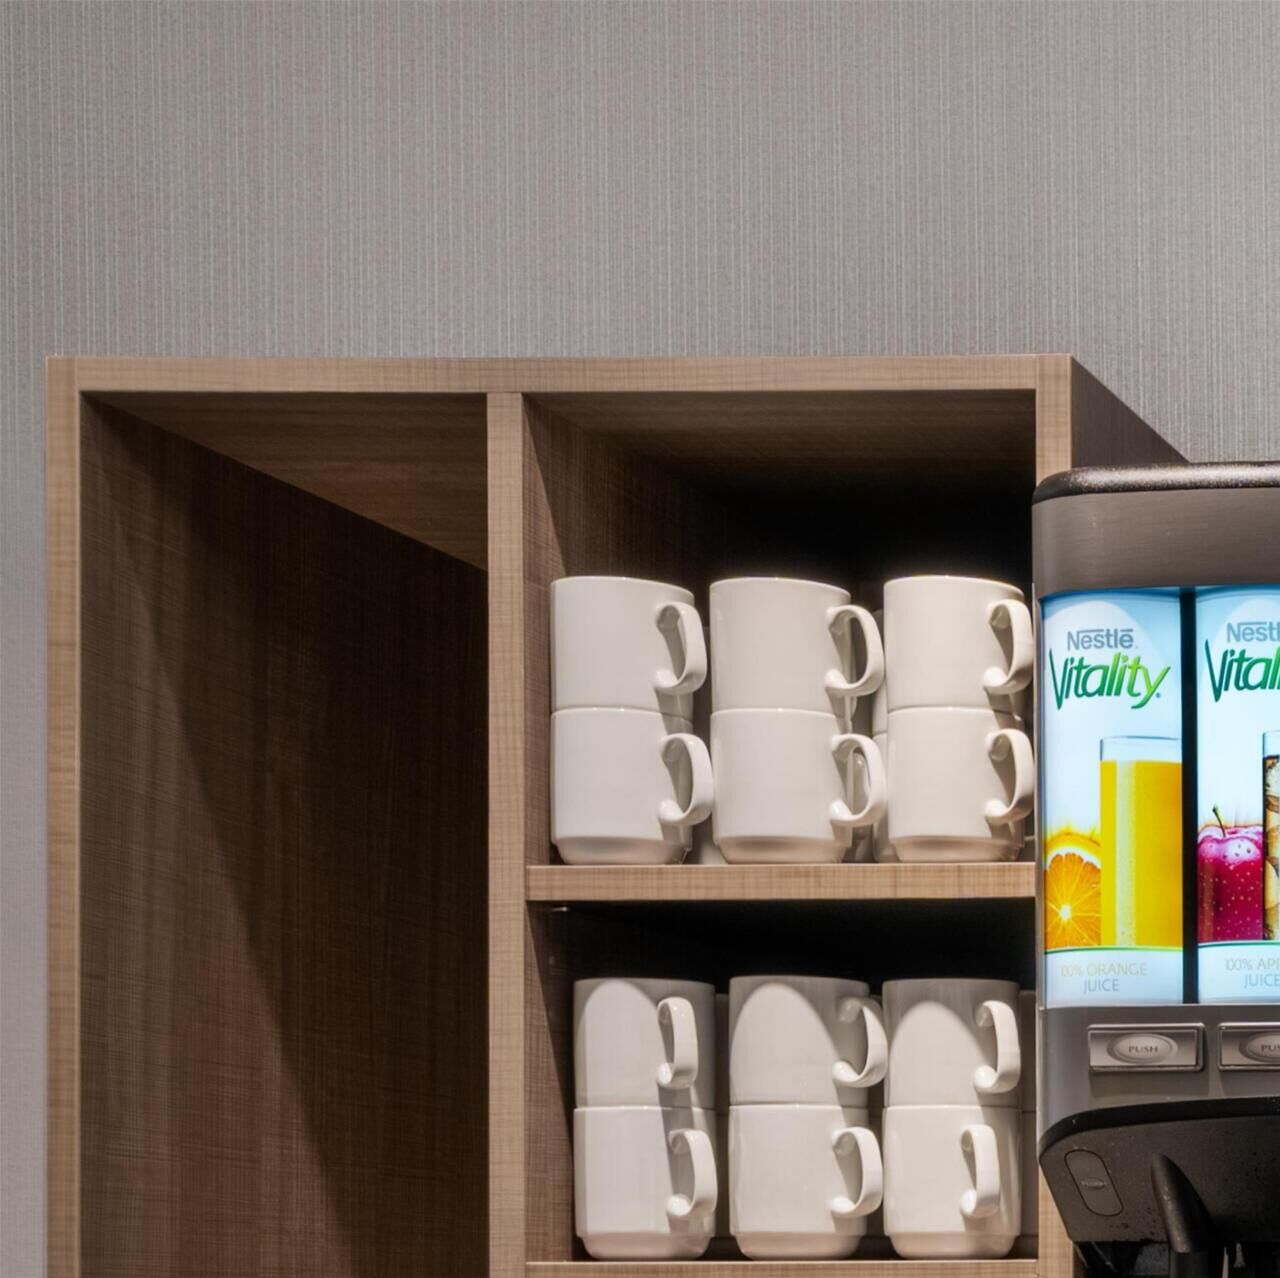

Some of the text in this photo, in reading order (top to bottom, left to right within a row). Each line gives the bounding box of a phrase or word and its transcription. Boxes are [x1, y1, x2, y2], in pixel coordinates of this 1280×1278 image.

[1050, 648, 1171, 710] Vitality
[1087, 961, 1149, 977] ORANGE
[1225, 957, 1254, 972] 100%
[1083, 977, 1121, 995] JUICE
[1128, 1045, 1159, 1053] PUSH
